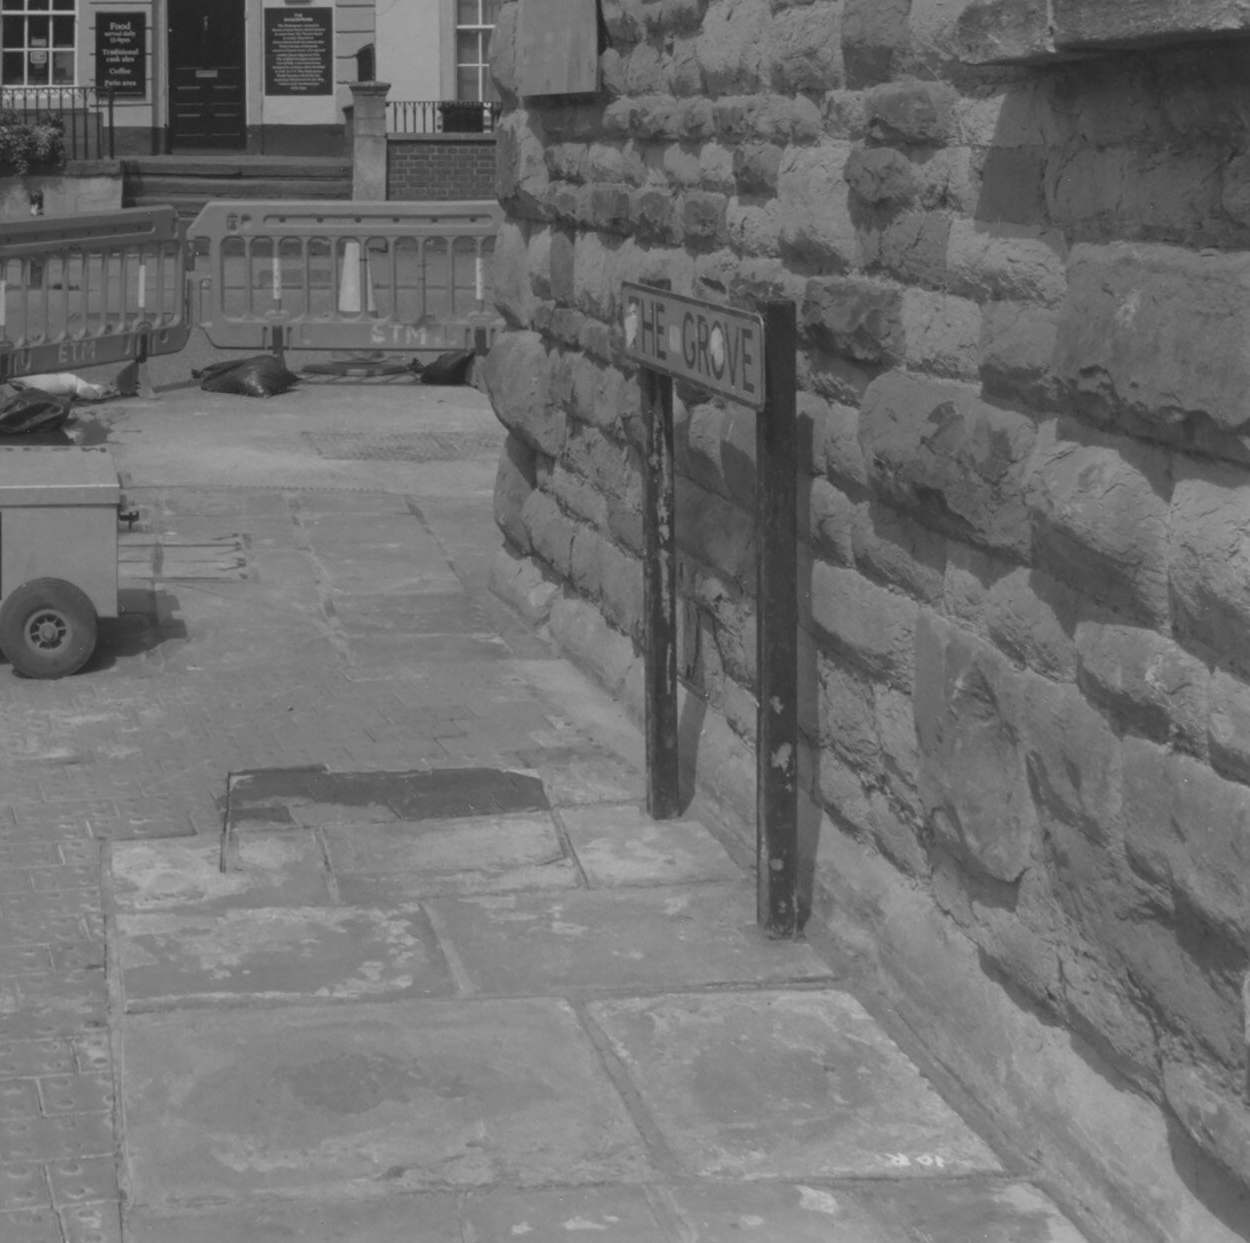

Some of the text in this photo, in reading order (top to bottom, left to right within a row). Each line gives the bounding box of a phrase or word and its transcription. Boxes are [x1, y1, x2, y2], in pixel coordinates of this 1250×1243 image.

[110, 22, 131, 30] Food
[372, 323, 427, 345] ETM
[58, 339, 96, 363] ETM
[682, 310, 755, 394] GROVE
